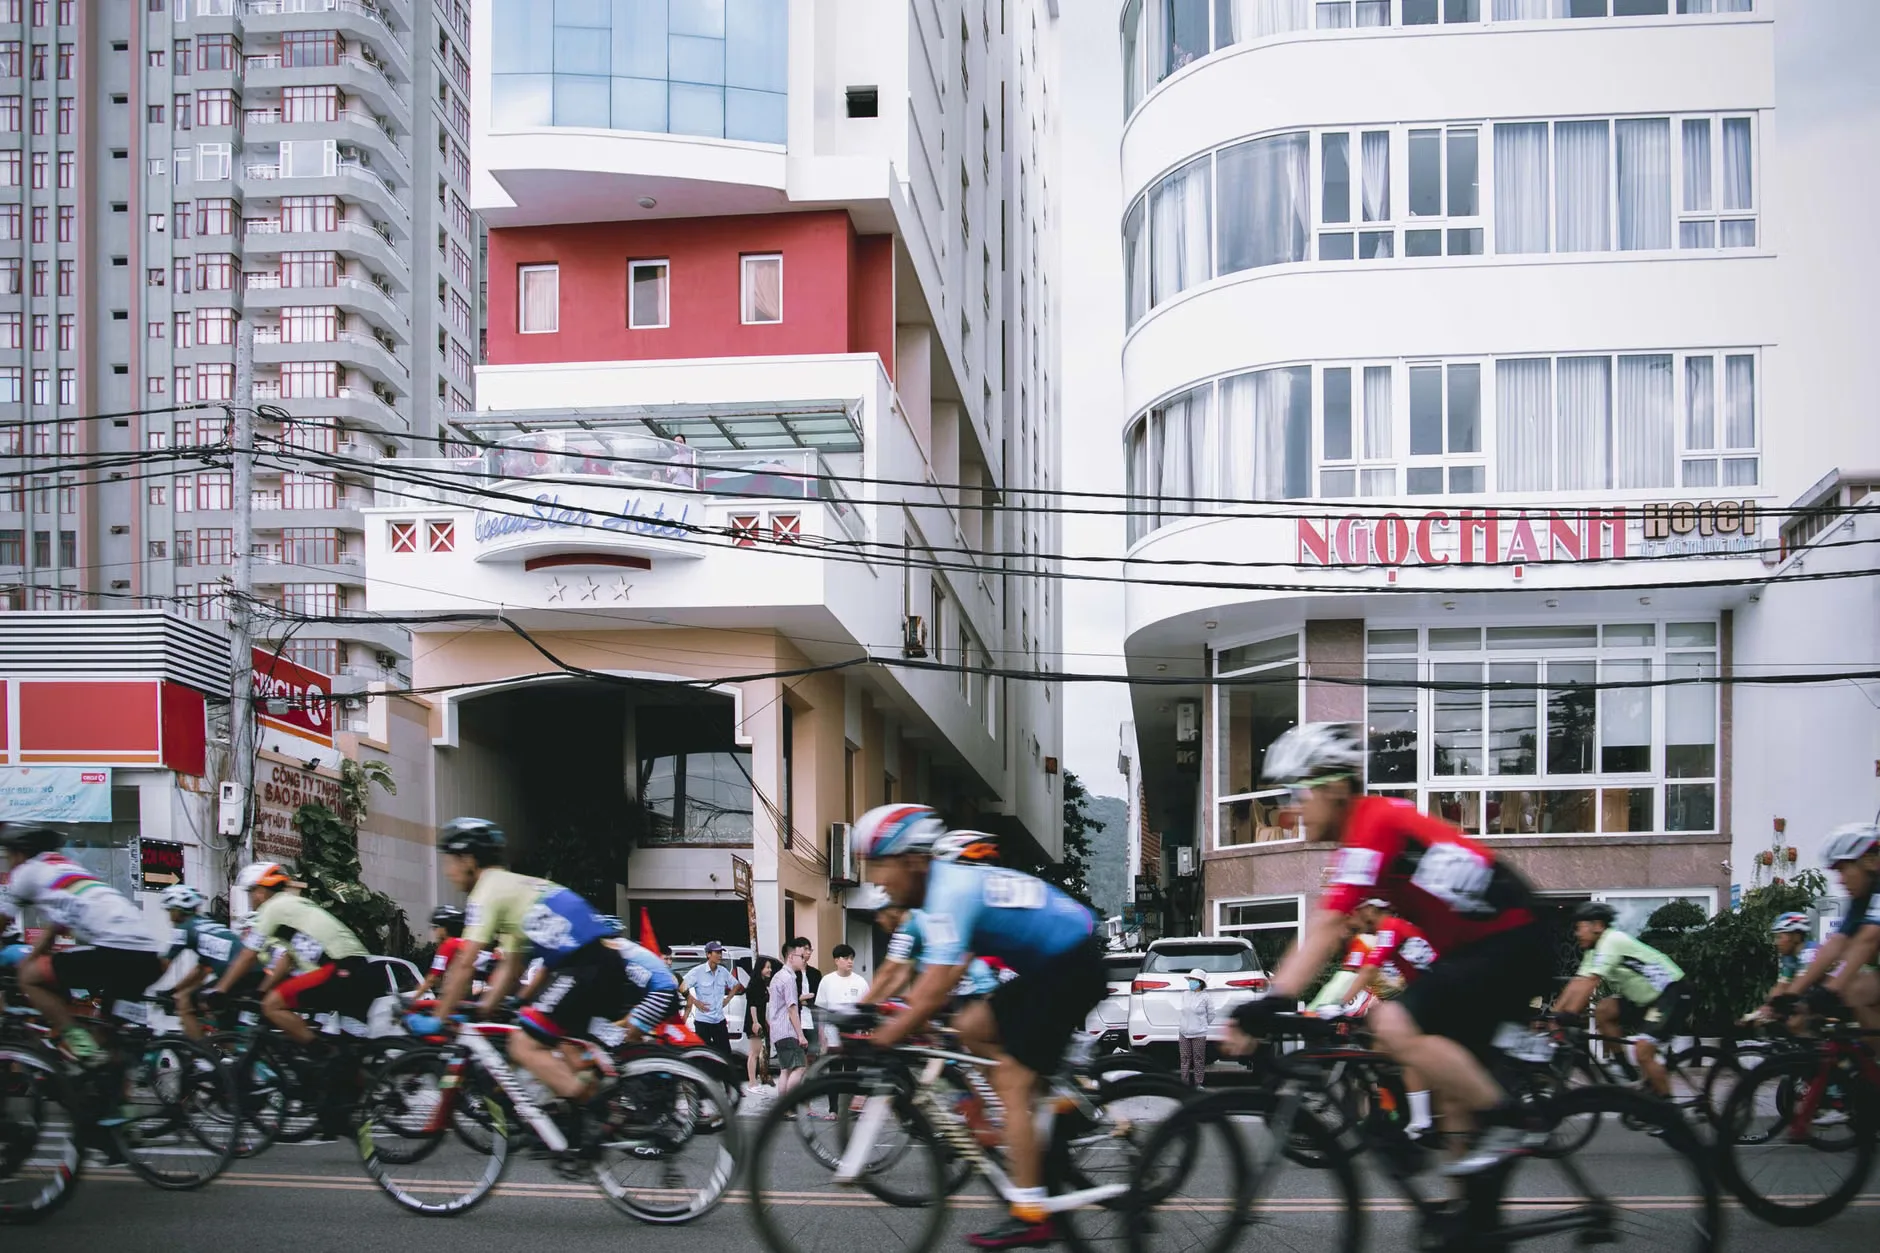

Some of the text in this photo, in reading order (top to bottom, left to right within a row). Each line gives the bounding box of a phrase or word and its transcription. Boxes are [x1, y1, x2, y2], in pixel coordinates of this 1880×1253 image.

[602, 496, 689, 538] Hotel
[1643, 499, 1756, 539] Hotel
[265, 782, 291, 806] SAO
[302, 775, 314, 791] TY
